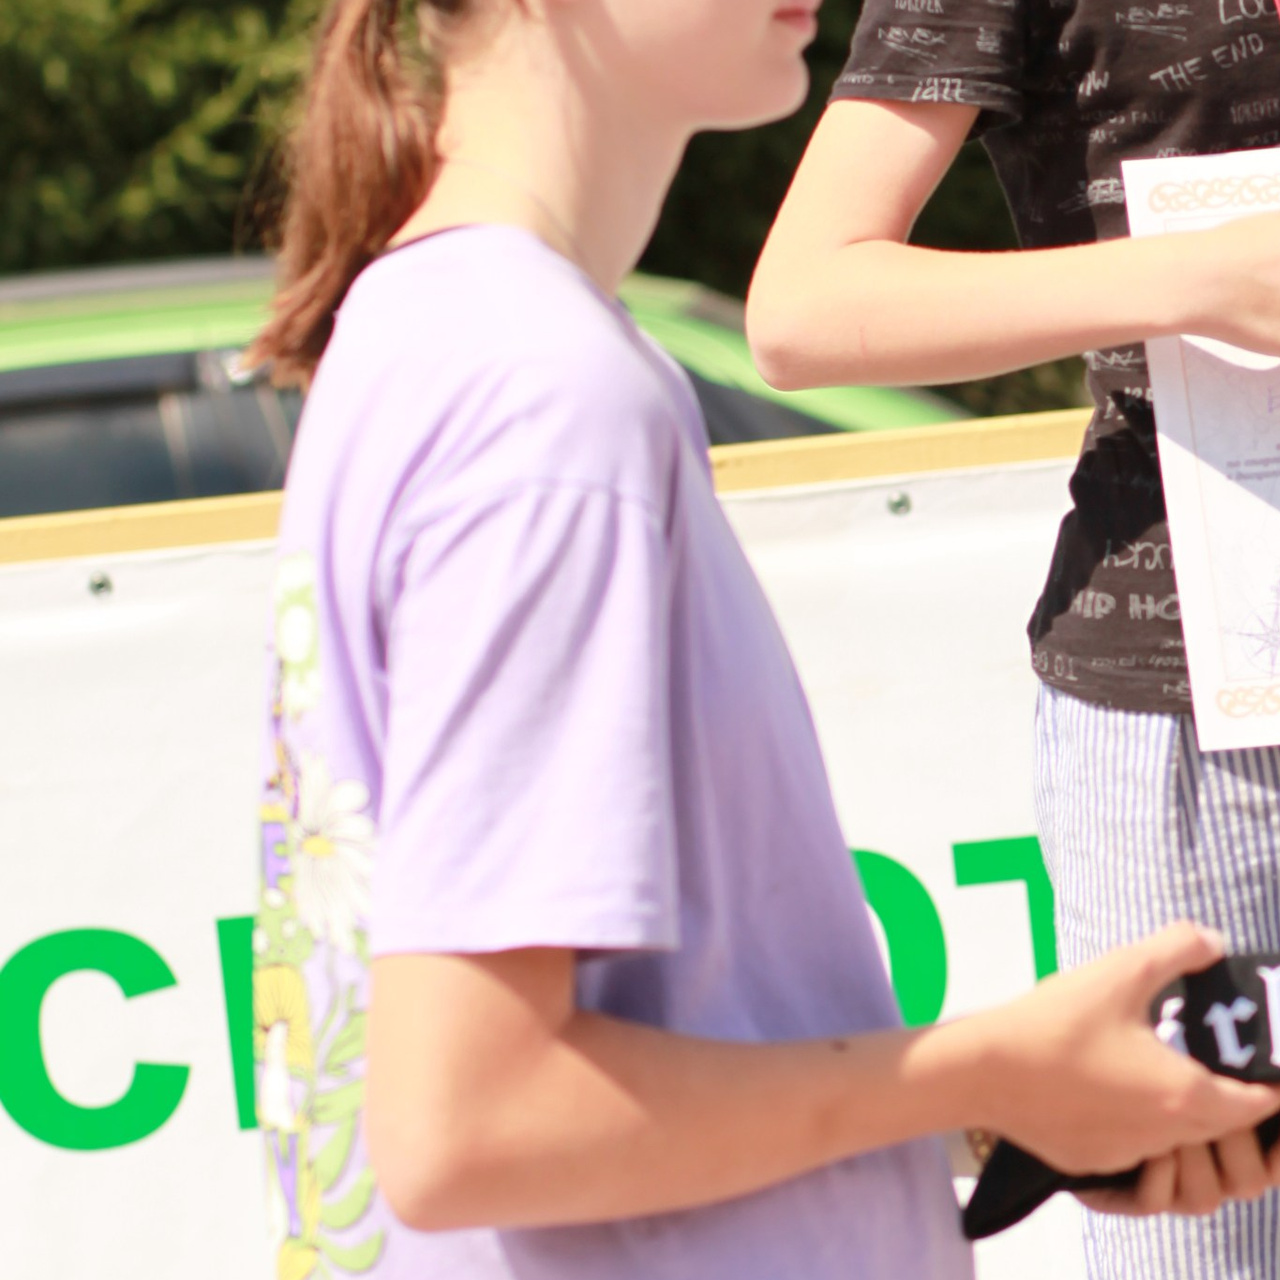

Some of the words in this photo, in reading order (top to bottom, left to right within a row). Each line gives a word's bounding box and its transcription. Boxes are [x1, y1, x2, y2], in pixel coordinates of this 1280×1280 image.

[1149, 57, 1208, 92] THE
[1212, 33, 1264, 68] END
[1103, 539, 1174, 570] UCKY
[1129, 592, 1181, 622] HO
